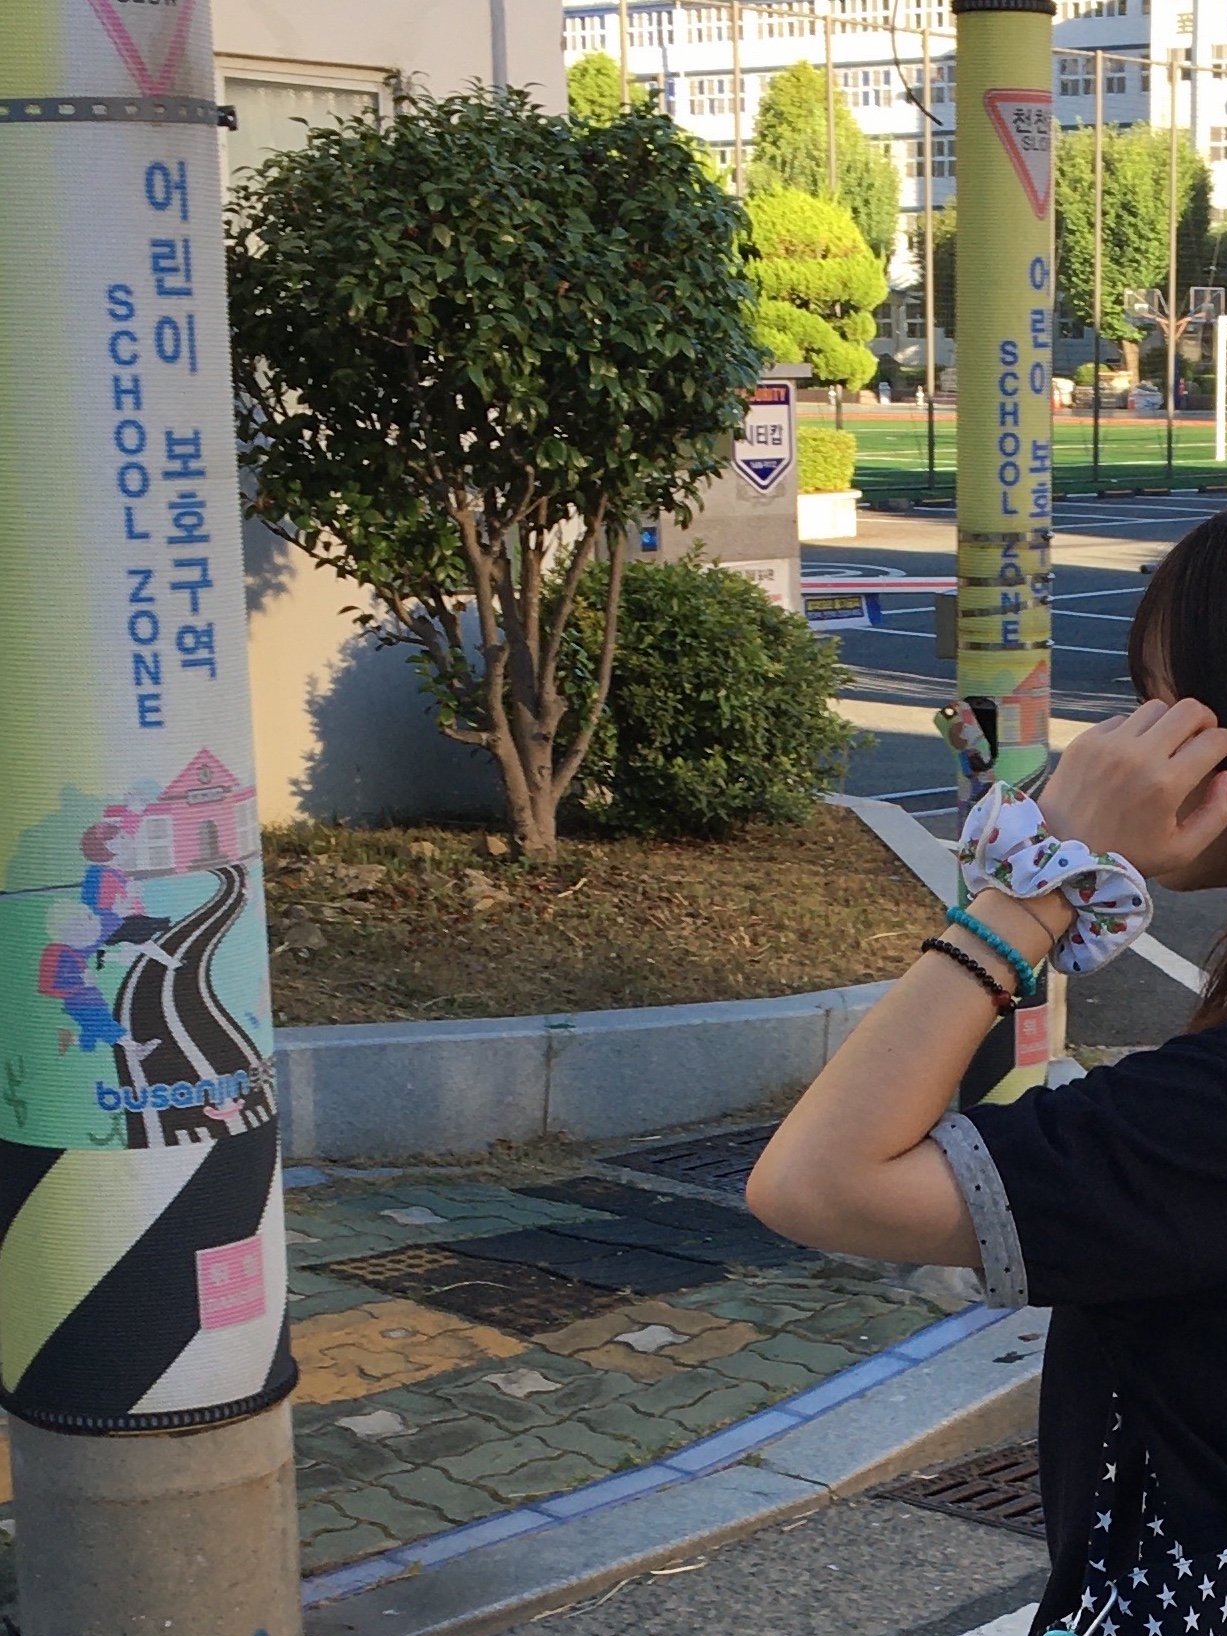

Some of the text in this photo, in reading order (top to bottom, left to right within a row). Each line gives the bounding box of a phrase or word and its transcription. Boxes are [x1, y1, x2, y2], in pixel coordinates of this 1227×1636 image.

[105, 283, 165, 729] SCHOOL ZONE
[145, 159, 217, 681] 어린이 보호구역
[998, 340, 1021, 515] SCHOOL
